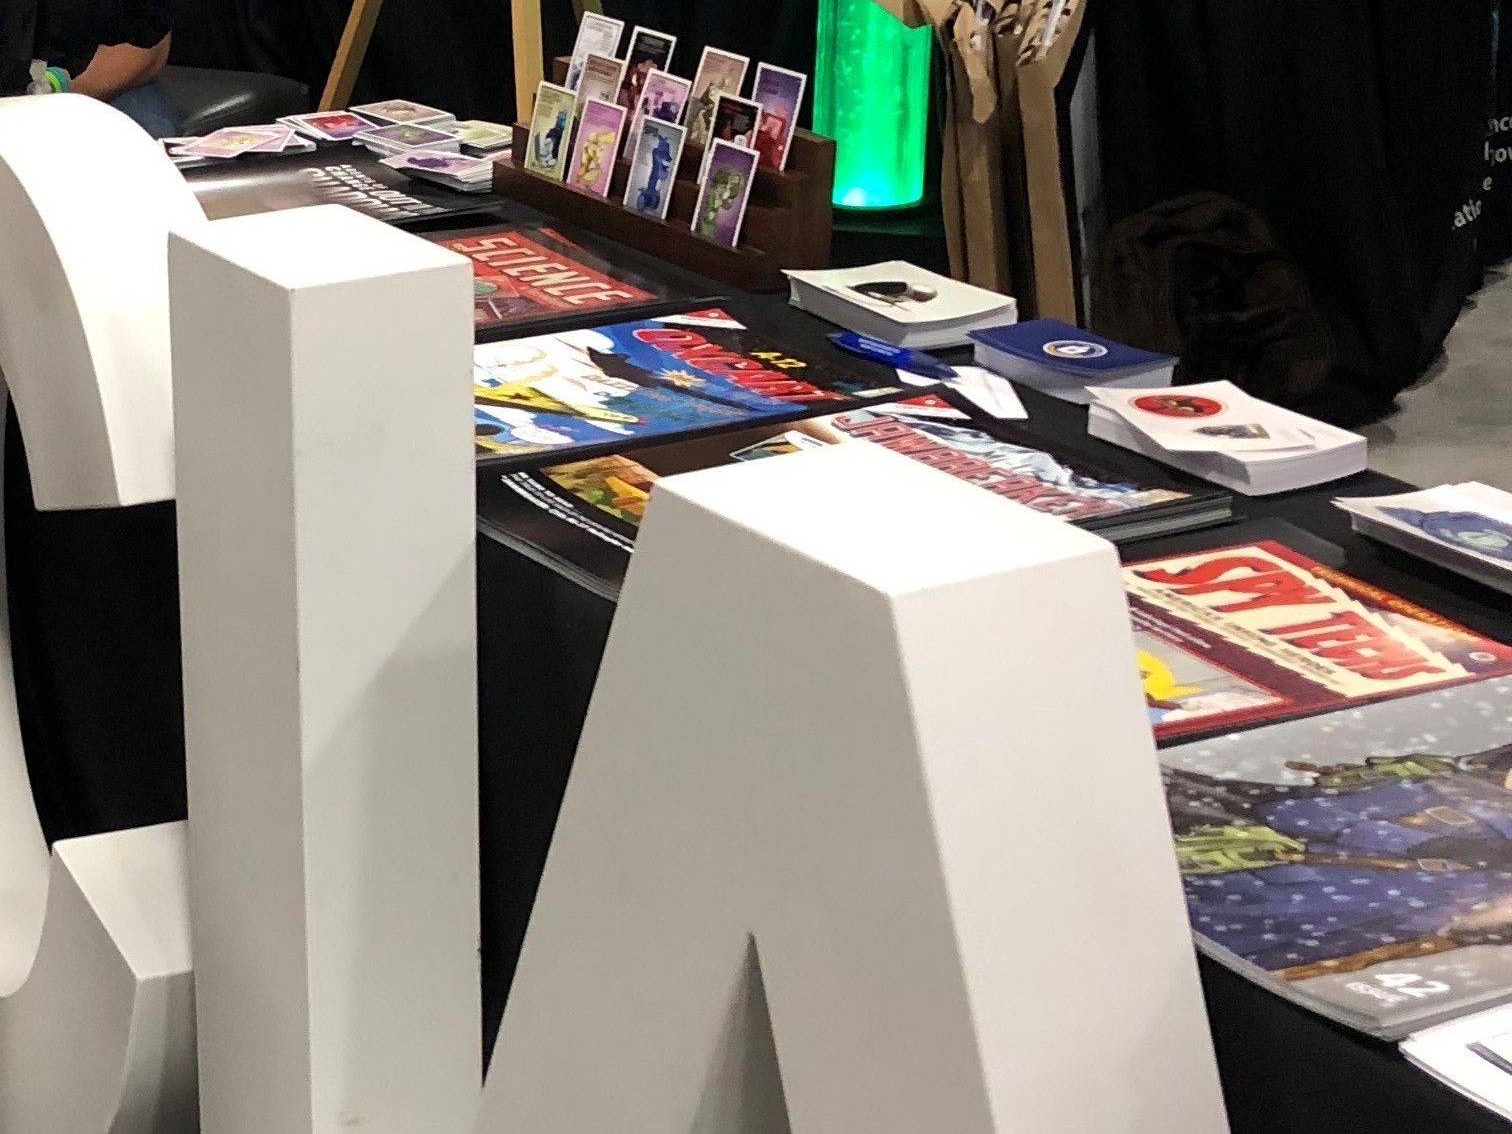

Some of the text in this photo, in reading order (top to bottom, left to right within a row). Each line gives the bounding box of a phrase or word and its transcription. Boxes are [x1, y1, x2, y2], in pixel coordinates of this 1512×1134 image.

[452, 237, 634, 305] SCIENCE
[1132, 556, 1337, 613] SPY
[1374, 973, 1451, 998] 42
